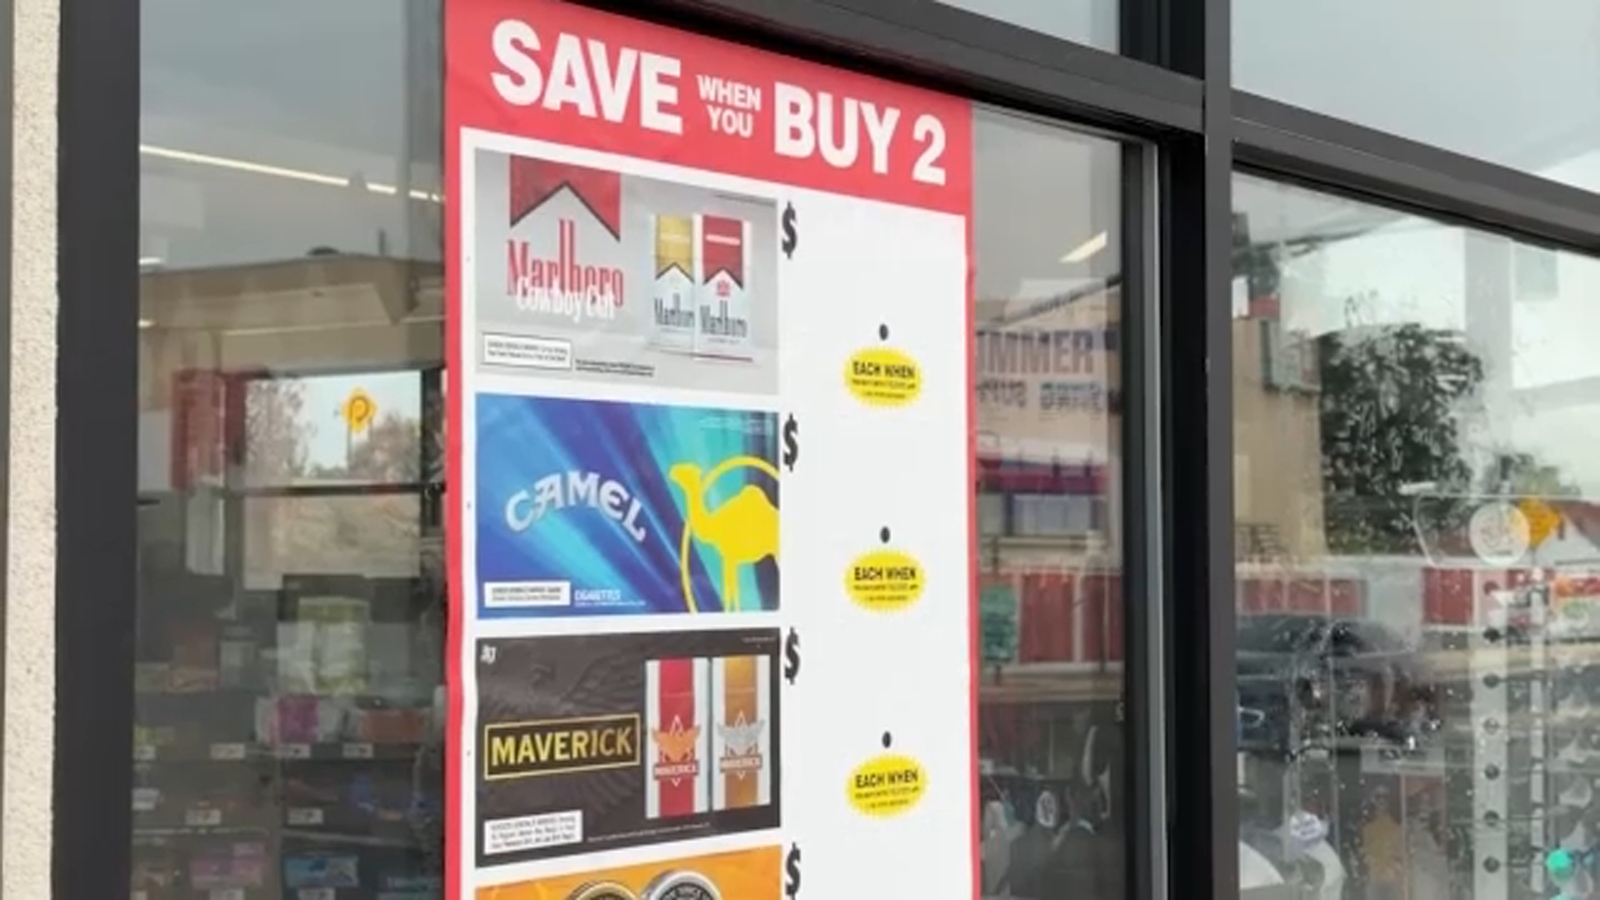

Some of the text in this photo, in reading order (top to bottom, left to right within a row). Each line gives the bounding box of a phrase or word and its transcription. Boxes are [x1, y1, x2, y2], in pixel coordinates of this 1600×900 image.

[490, 19, 683, 135] SAVE
[697, 75, 761, 111] WHEN
[707, 105, 753, 138] YOU
[774, 82, 947, 186] BUY 2
[781, 200, 797, 259] $
[506, 218, 624, 308] Marlboro
[852, 360, 916, 380] EACH WHEN
[782, 413, 798, 472] $
[505, 470, 647, 542] CAMEL
[854, 566, 916, 581] EACH WHEN
[784, 627, 800, 685] $
[491, 726, 633, 767] MAVERICK
[855, 768, 918, 788] EACH WHEN
[785, 841, 801, 900] $
